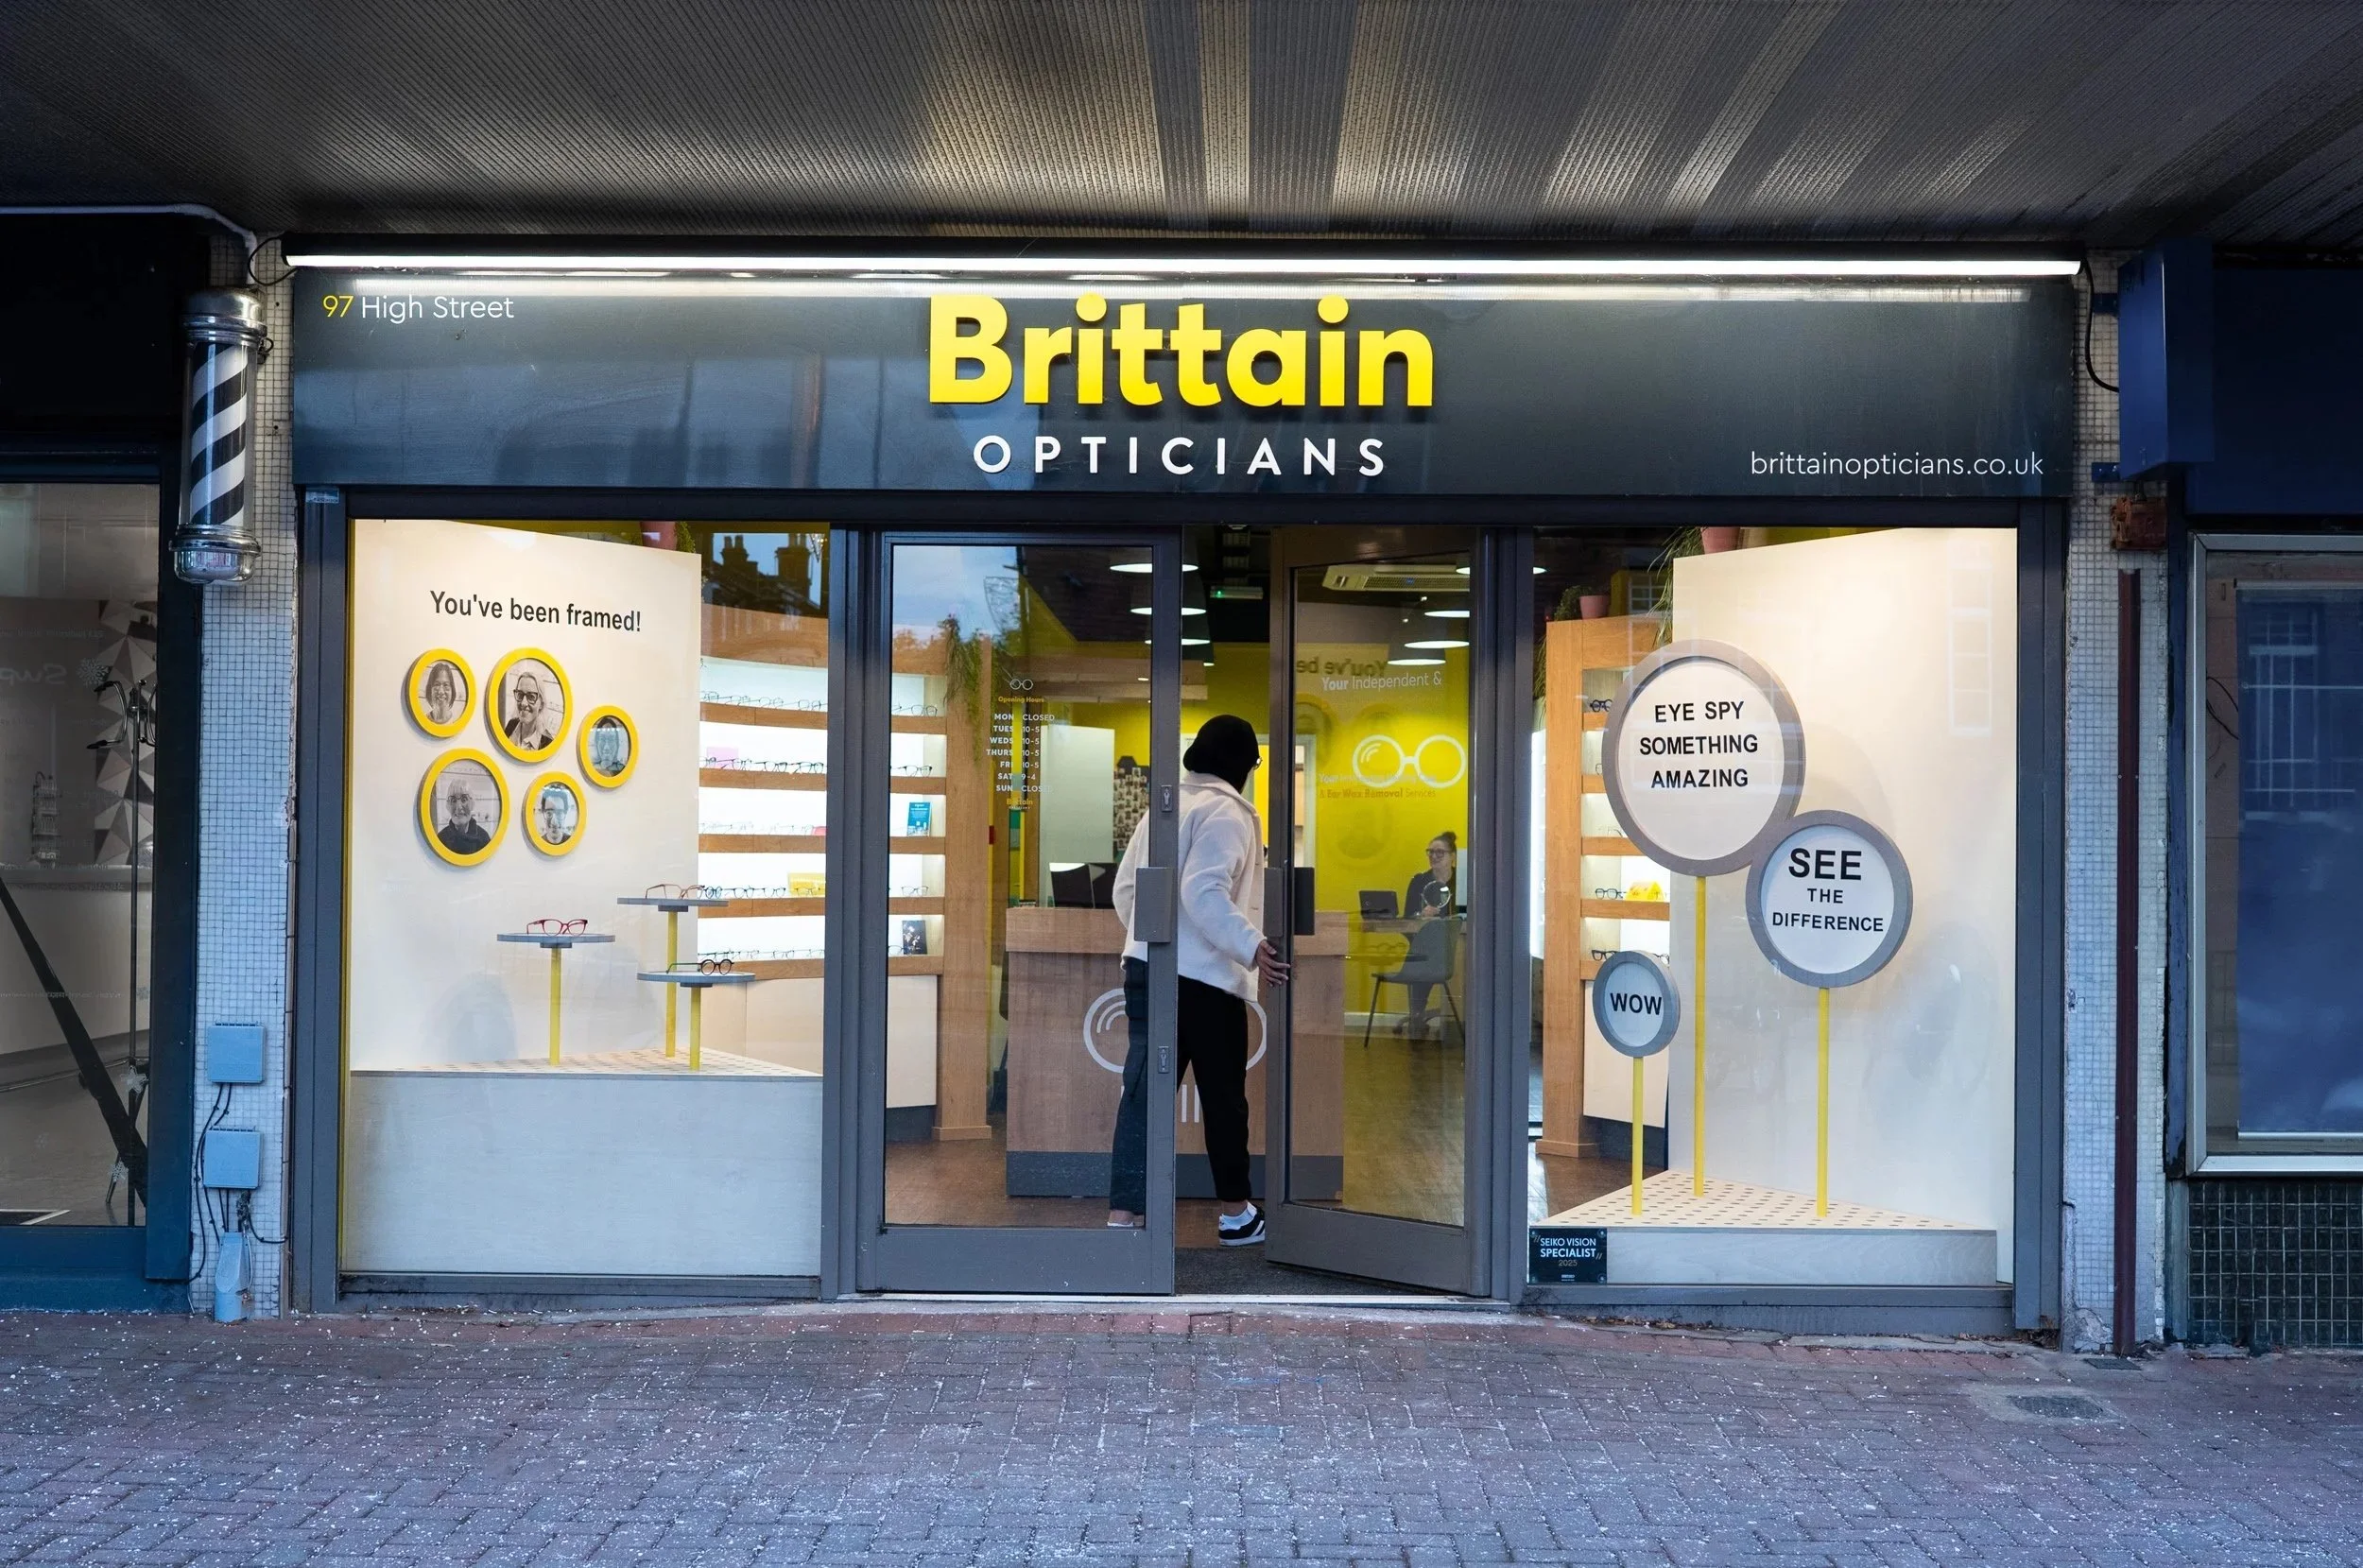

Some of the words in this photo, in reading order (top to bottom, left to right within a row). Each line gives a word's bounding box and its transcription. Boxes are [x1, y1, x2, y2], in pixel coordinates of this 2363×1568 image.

[322, 295, 354, 318] 97
[361, 294, 423, 324] High
[433, 296, 515, 319] Street
[929, 294, 1434, 407] Brittain
[973, 435, 1385, 476] OPTICIANS
[1751, 451, 2044, 479] brittainopticians.co.uk
[430, 590, 503, 619] You've
[510, 597, 561, 624] been
[566, 603, 642, 632] framed!
[1321, 677, 1350, 691] Your
[1352, 672, 1429, 692] Independent
[1433, 671, 1442, 685] &
[1654, 702, 1696, 723] EYE
[1704, 700, 1745, 720] SPY
[986, 749, 1014, 757] THURS
[1639, 733, 1759, 756] SOMETHING
[1650, 768, 1749, 789] AMAZING
[1788, 848, 1862, 881] SEE
[1806, 887, 1844, 905] THE
[1772, 911, 1884, 932] DIFFERENCE
[1610, 992, 1663, 1016] WOW
[1540, 1237, 1565, 1247] SEIKO
[1566, 1237, 1596, 1247] VISION
[1540, 1248, 1597, 1258] SPECIALIST
[1558, 1259, 1578, 1267] 2025
